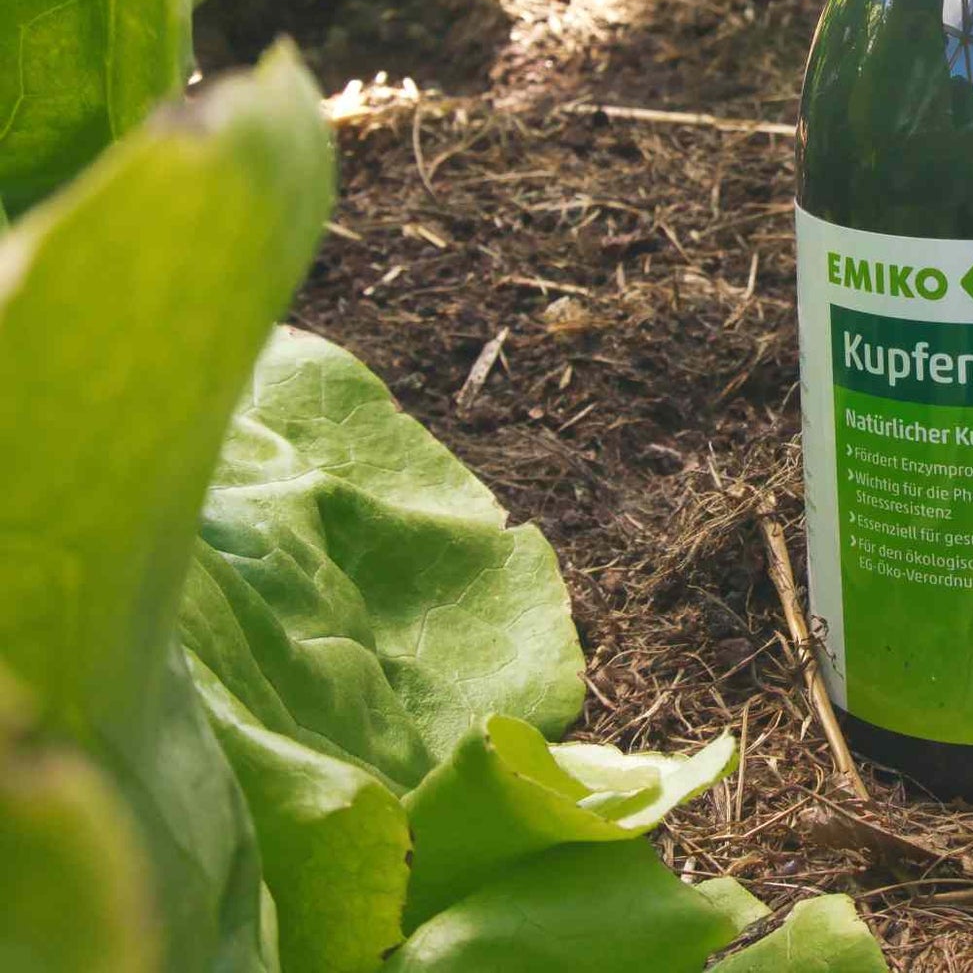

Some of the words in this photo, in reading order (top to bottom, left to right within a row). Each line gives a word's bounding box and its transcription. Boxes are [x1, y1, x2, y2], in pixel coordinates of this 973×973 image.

[827, 252, 948, 300] EMIKO
[844, 331, 973, 387] Kupfer
[846, 409, 949, 444] Natürlicher
[855, 447, 898, 469] Fördert
[855, 471, 899, 497] Wichtig
[903, 482, 922, 497] für
[926, 485, 949, 500] die
[856, 489, 952, 519] Stressresistenz
[858, 514, 917, 540] Essenziell
[920, 527, 940, 543] für
[859, 538, 876, 553] Für
[879, 543, 902, 560] den
